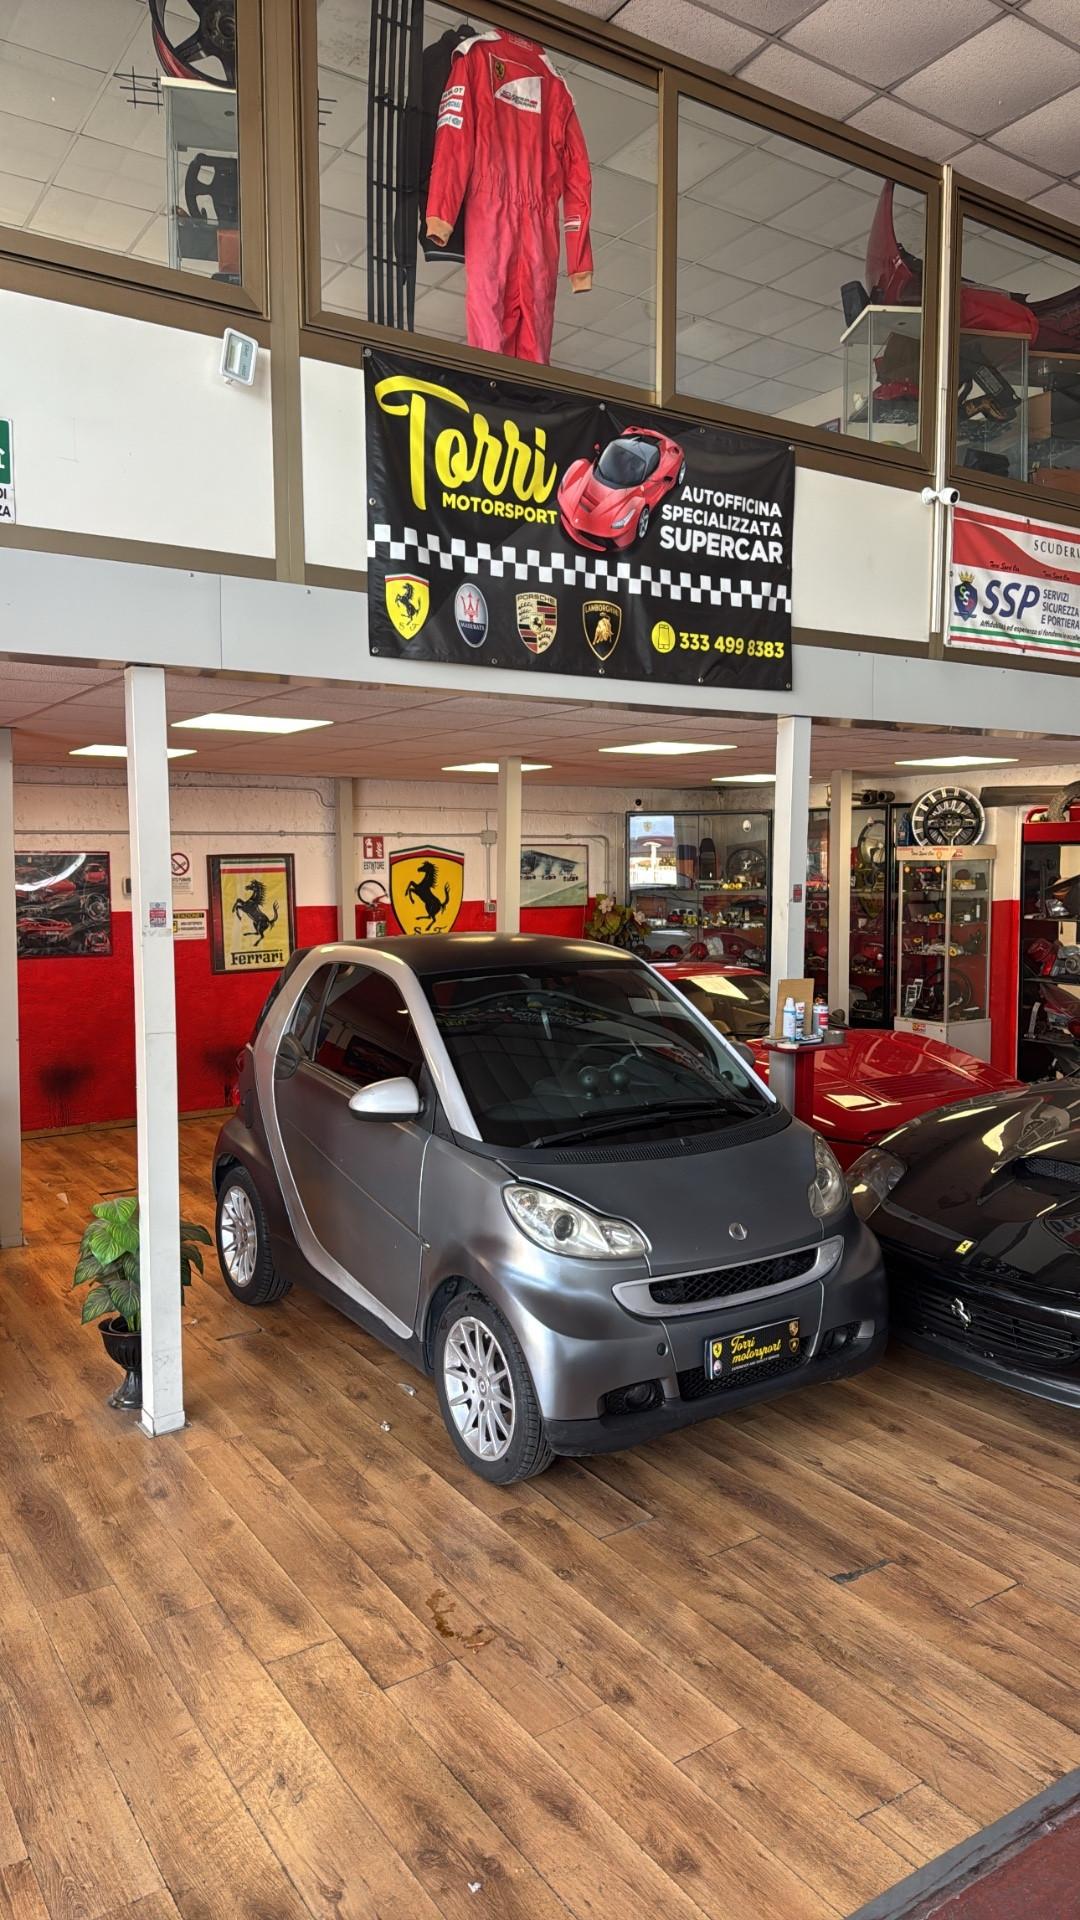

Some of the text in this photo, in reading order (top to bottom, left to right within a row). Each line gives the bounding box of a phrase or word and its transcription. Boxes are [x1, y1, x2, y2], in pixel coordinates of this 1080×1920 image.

[375, 376, 557, 510] Torri
[442, 492, 558, 525] MOTORSPORT
[681, 485, 783, 518] AUTOFFICINA
[661, 504, 783, 537] SPECIALIZZATA
[659, 525, 783, 564] SUPERCAR
[1034, 539, 1080, 559] SCUDERI
[518, 593, 556, 605] PORSCHE
[982, 580, 1040, 619] SSP
[1043, 589, 1069, 603] SERVIZI
[1041, 615, 1047, 624] E
[1042, 602, 1079, 617] SICUREZZA
[679, 632, 785, 659] 333 499 8383
[231, 949, 284, 965] Ferrari
[731, 1334, 755, 1354] Torri
[732, 1339, 781, 1364] motorsport
